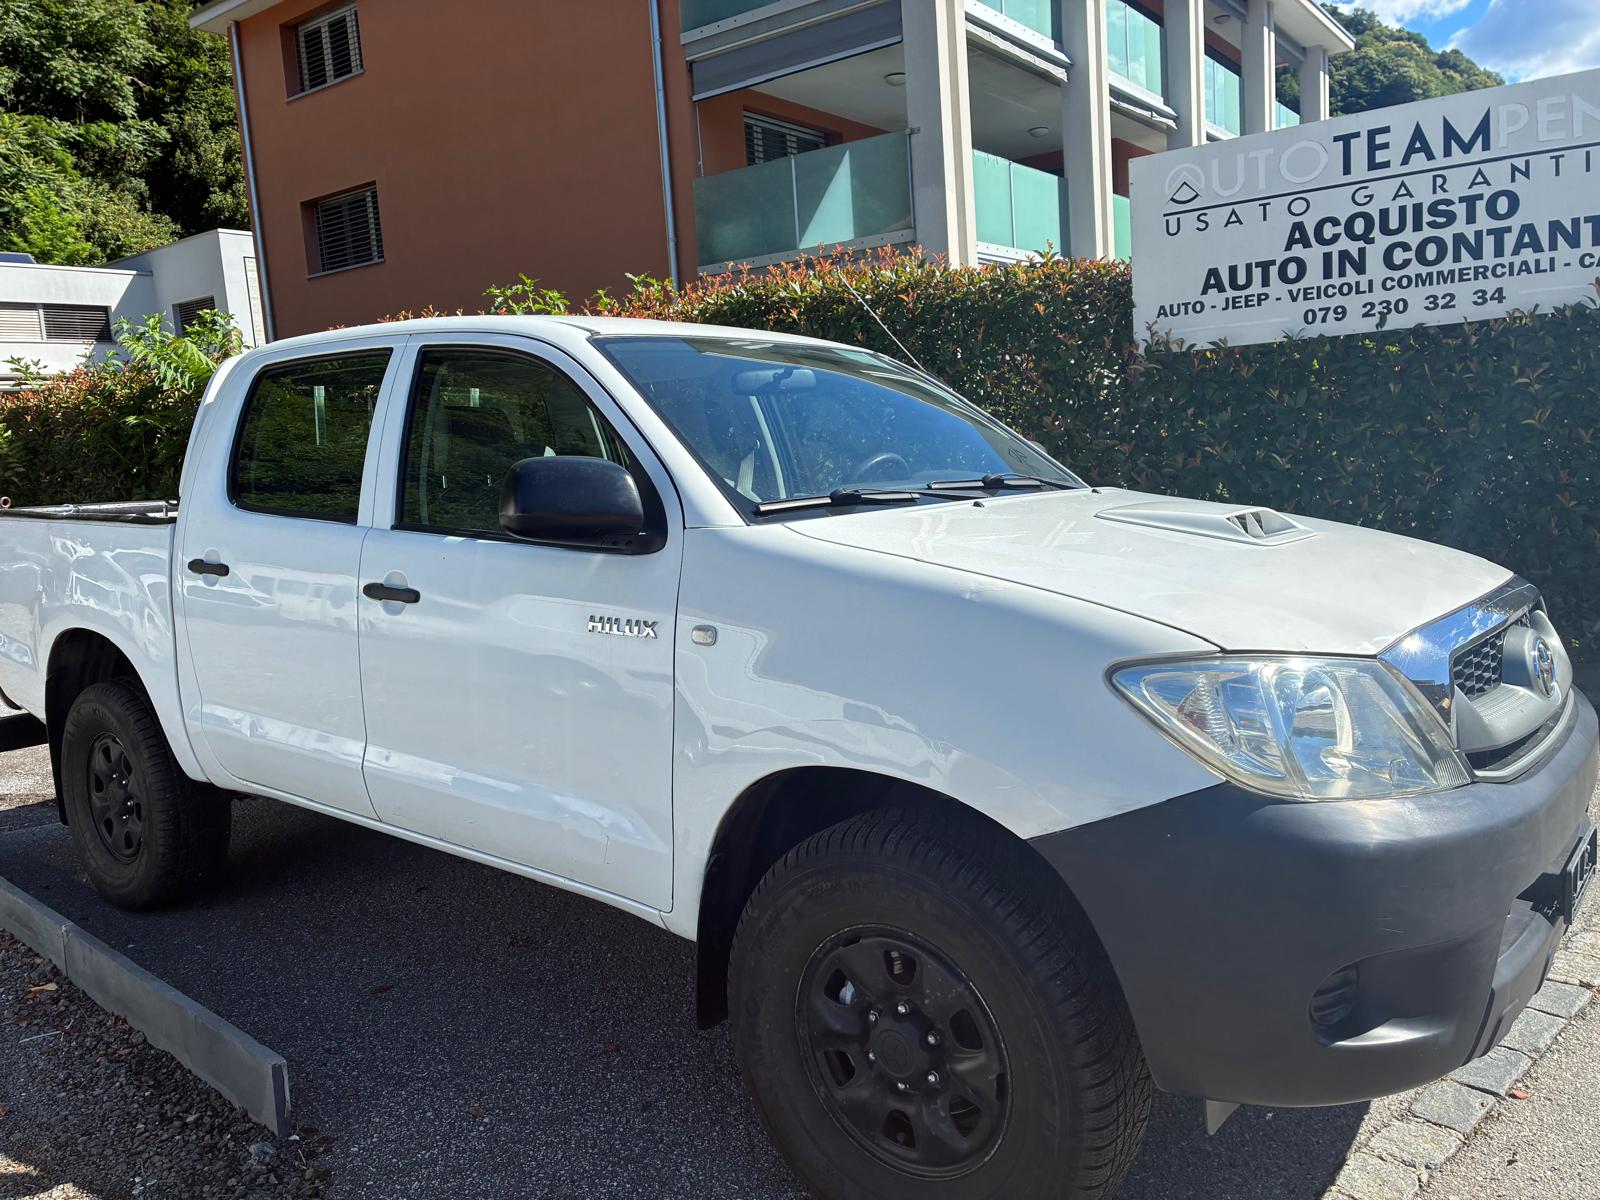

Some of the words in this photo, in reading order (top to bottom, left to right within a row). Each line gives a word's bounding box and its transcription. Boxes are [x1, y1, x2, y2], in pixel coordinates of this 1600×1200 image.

[1333, 106, 1491, 176] TEAM
[1165, 196, 1311, 236] USATO
[1351, 150, 1591, 207] GARANTI
[1284, 189, 1520, 251] ACQUISTO
[1156, 300, 1205, 319] AUTO
[1222, 292, 1270, 311] JEEP
[1287, 279, 1374, 302] VEICOLI
[1381, 256, 1556, 292] COMMERCIALI
[1201, 256, 1307, 295] AUTO
[1323, 246, 1367, 280] IN
[1303, 304, 1348, 325] 079
[1361, 298, 1409, 318] 230
[1423, 292, 1456, 311] 32
[1472, 286, 1506, 306] 34
[588, 615, 658, 639] HILUX
